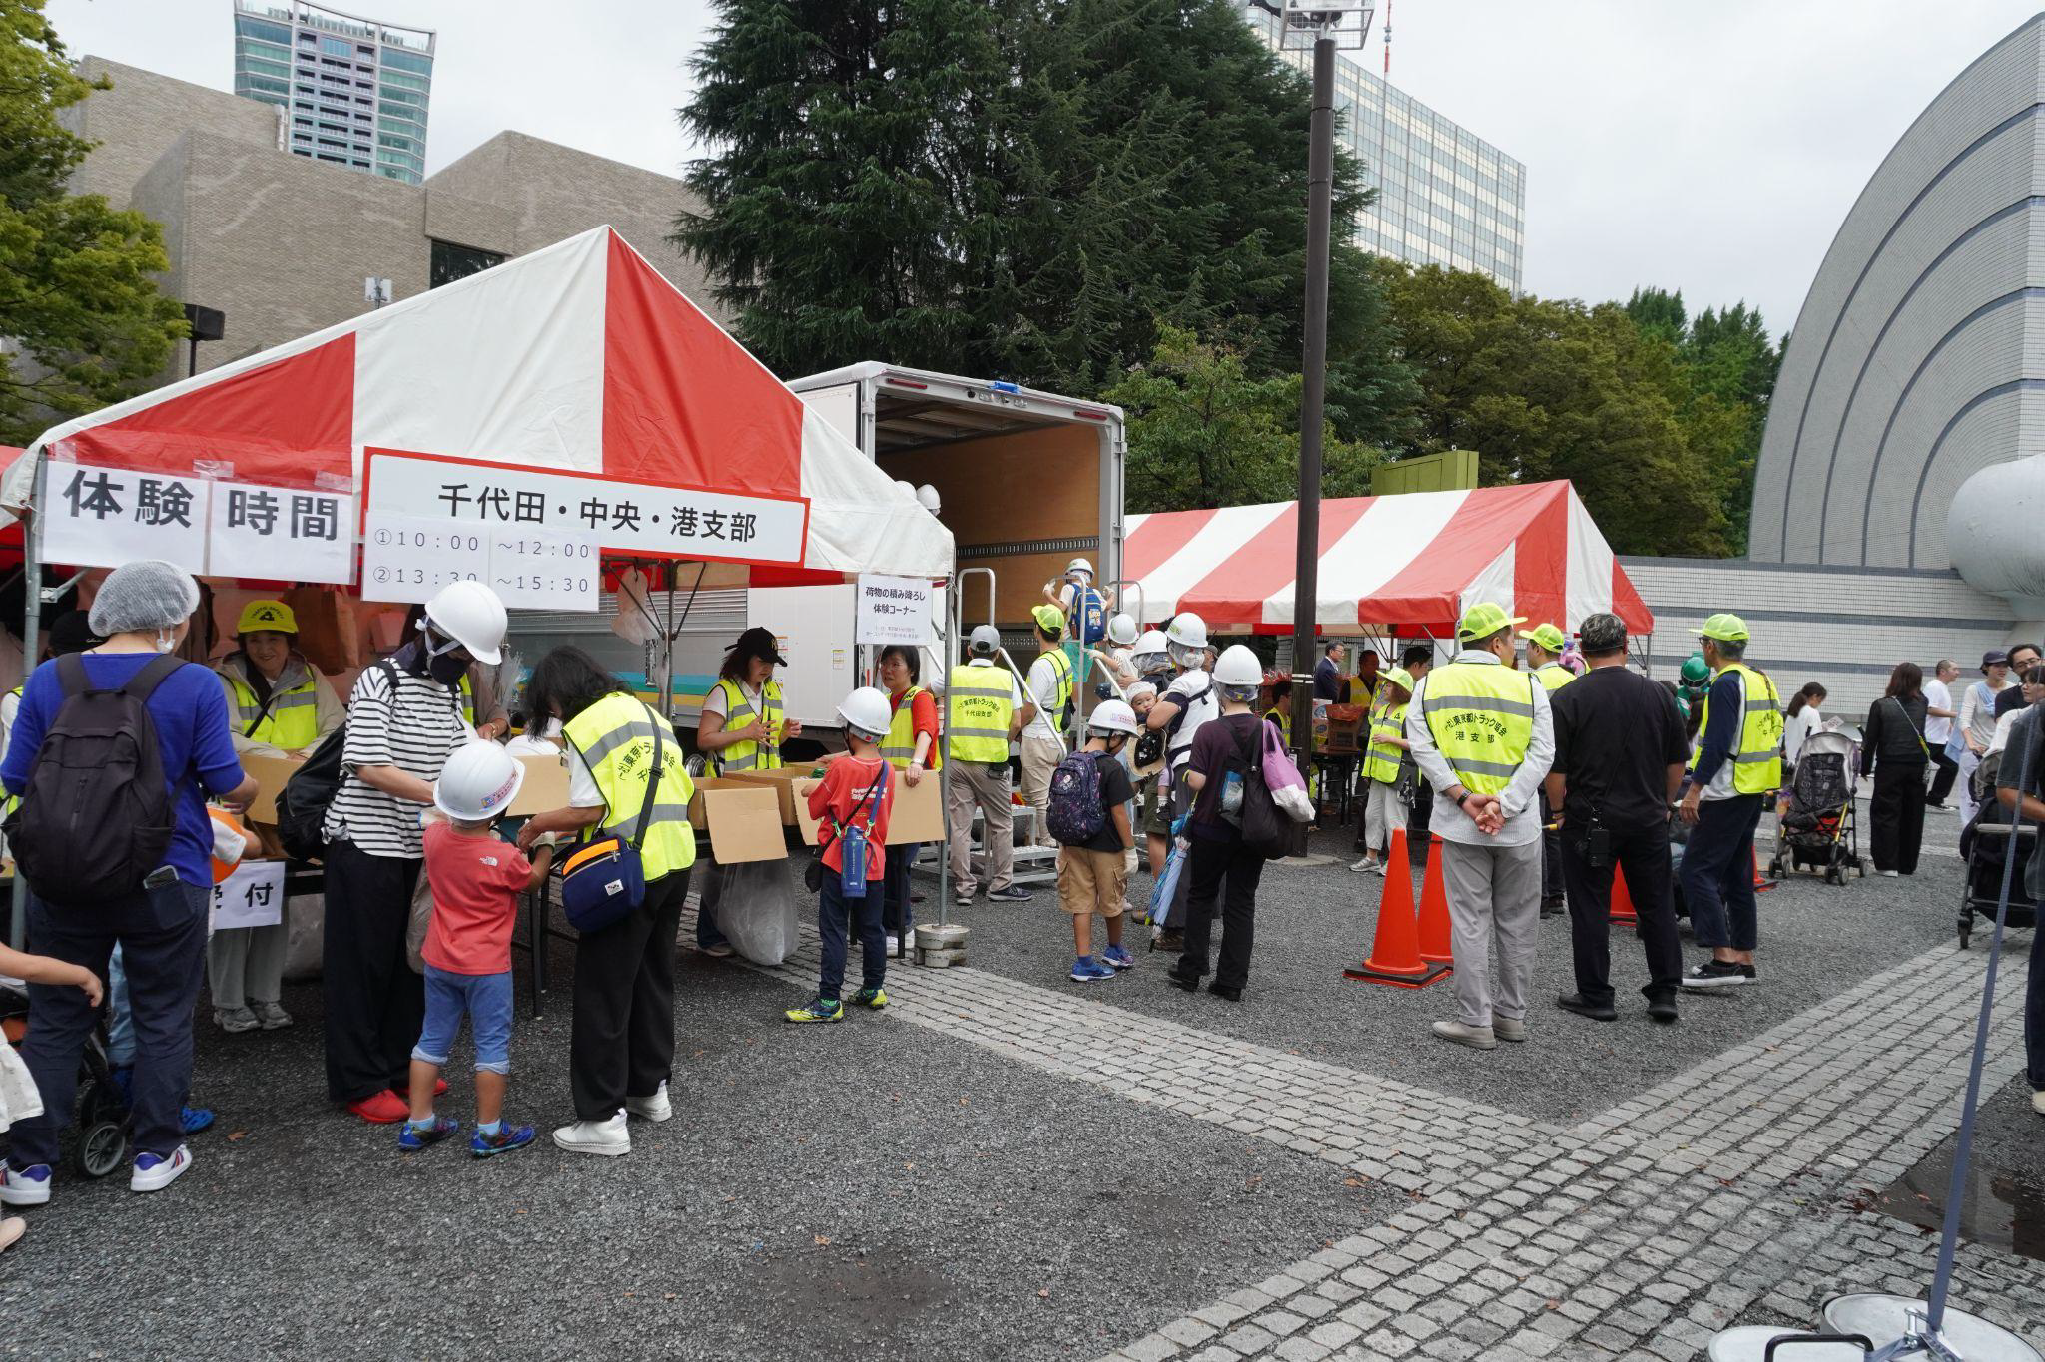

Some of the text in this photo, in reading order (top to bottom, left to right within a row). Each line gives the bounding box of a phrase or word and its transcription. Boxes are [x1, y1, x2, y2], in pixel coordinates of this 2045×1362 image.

[62, 469, 339, 541] 体験 時間
[438, 484, 757, 542] 千代田・中央・港支部
[865, 586, 926, 601] 荷物の積み降ろし
[873, 603, 917, 616] 体験コーナー
